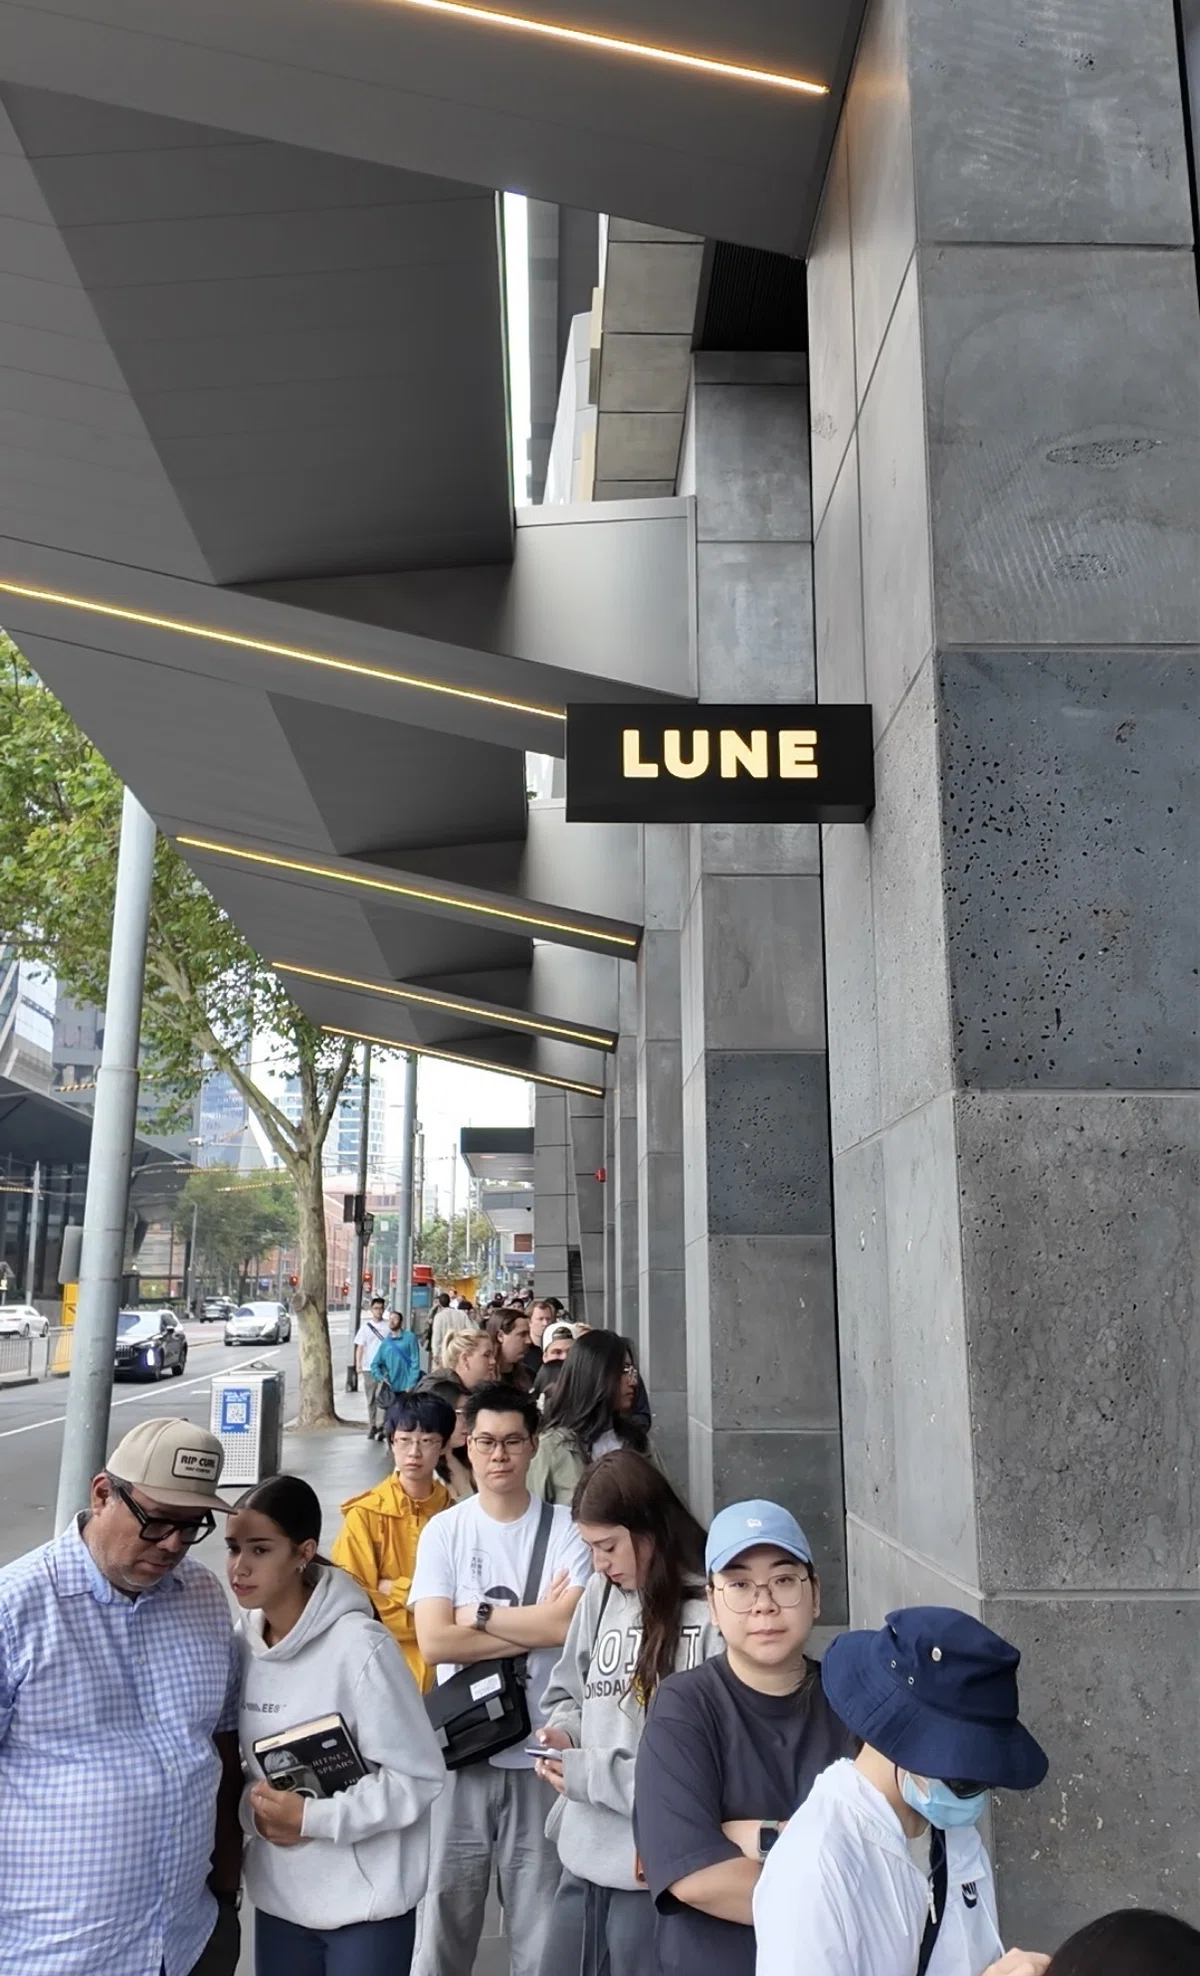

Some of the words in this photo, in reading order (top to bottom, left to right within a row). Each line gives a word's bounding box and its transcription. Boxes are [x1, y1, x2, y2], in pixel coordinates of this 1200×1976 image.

[622, 729, 818, 779] LUNE
[181, 1455, 197, 1465] RIP
[312, 1750, 350, 1768] RITNEY
[317, 1760, 354, 1775] SPEARS
